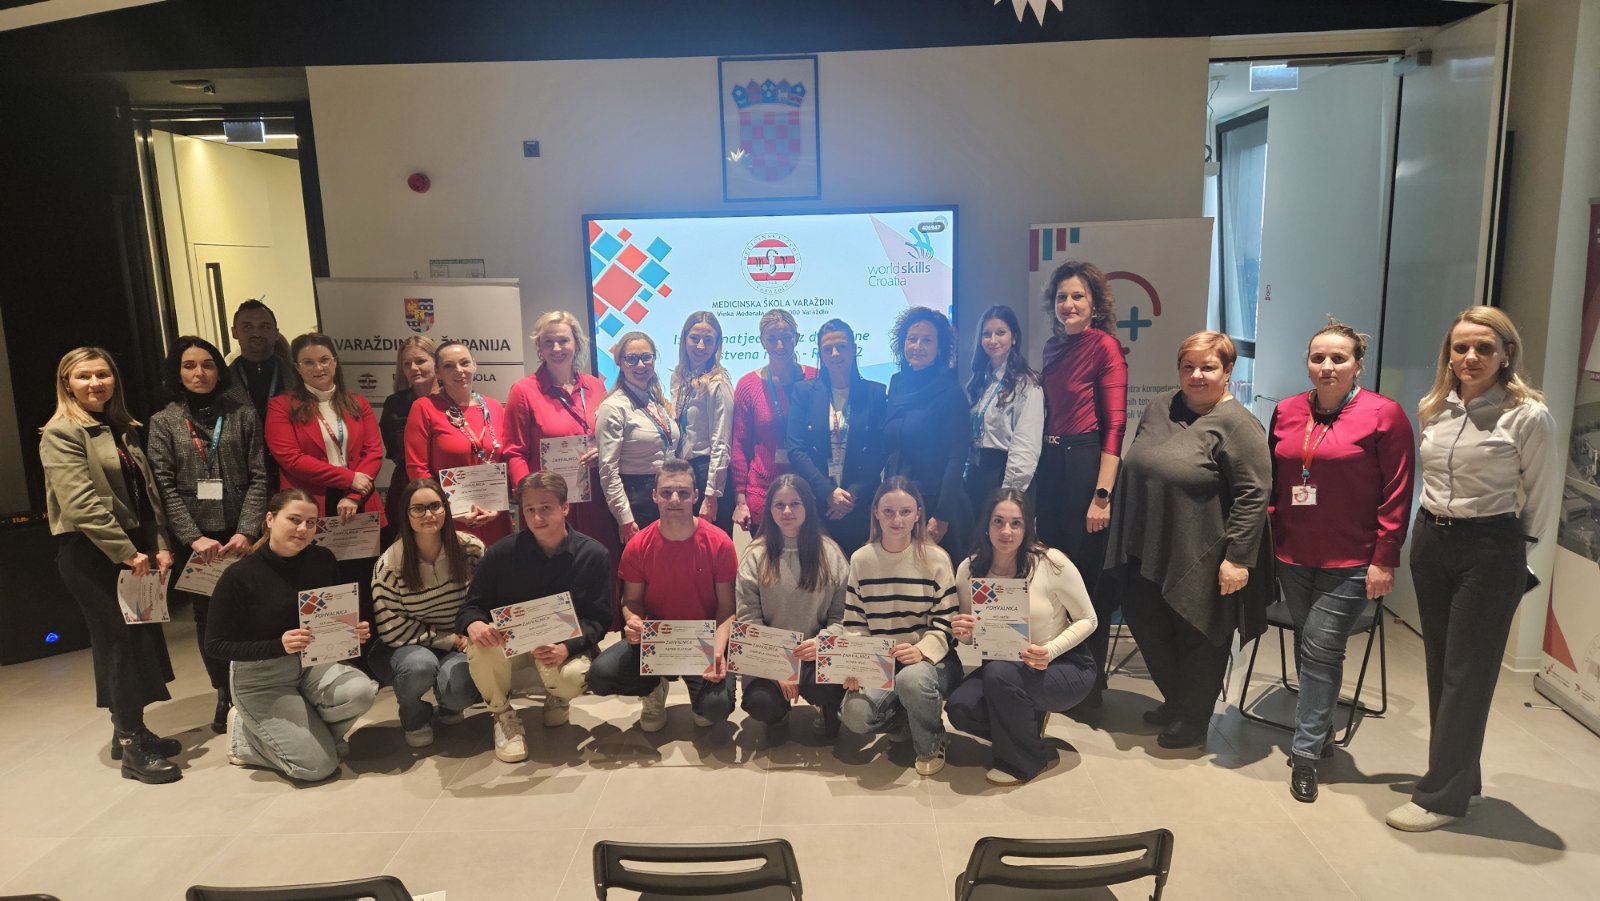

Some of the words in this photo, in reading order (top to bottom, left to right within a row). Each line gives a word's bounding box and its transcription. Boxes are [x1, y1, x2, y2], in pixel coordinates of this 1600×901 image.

[868, 275, 907, 287] Croatia
[711, 300, 762, 309] MEDICINSKA
[763, 299, 791, 308] ŠKOLA
[793, 297, 834, 307] VARAŽDIN
[334, 336, 434, 351] VARAŽDI
[721, 333, 761, 346] natjec
